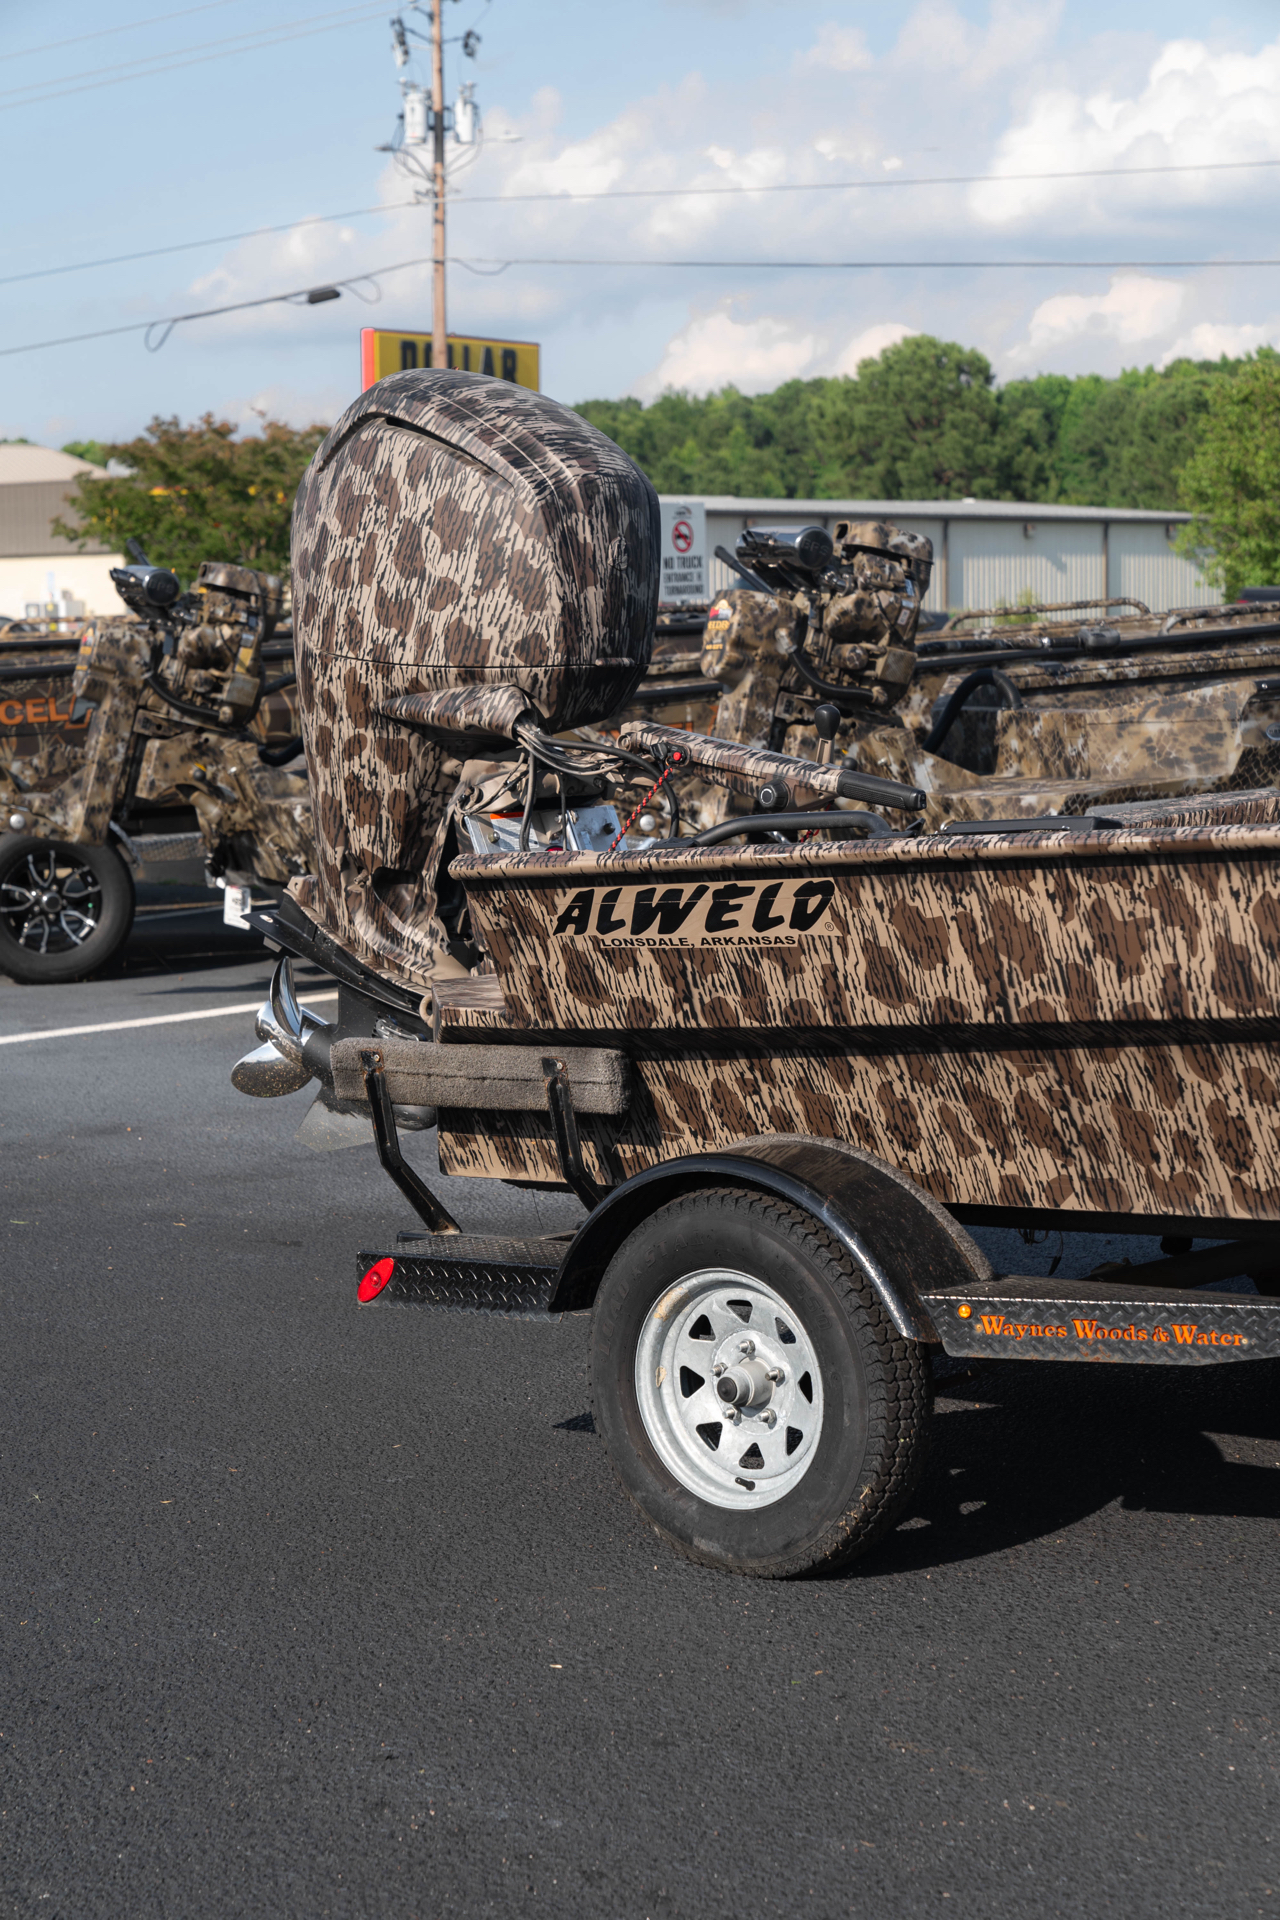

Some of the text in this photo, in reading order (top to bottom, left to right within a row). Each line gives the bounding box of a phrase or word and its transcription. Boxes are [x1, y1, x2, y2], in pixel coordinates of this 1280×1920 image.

[401, 341, 517, 383] DAR
[663, 555, 703, 569] NO TRUCK
[663, 572, 694, 583] ENTRANCE
[664, 584, 703, 596] TURNAROUND
[553, 880, 835, 936] ALWELD
[601, 935, 797, 948] LONSDALE, ARKANSAS
[774, 1260, 832, 1332] K550
[980, 1314, 1243, 1347] Waynes Woods & Water
